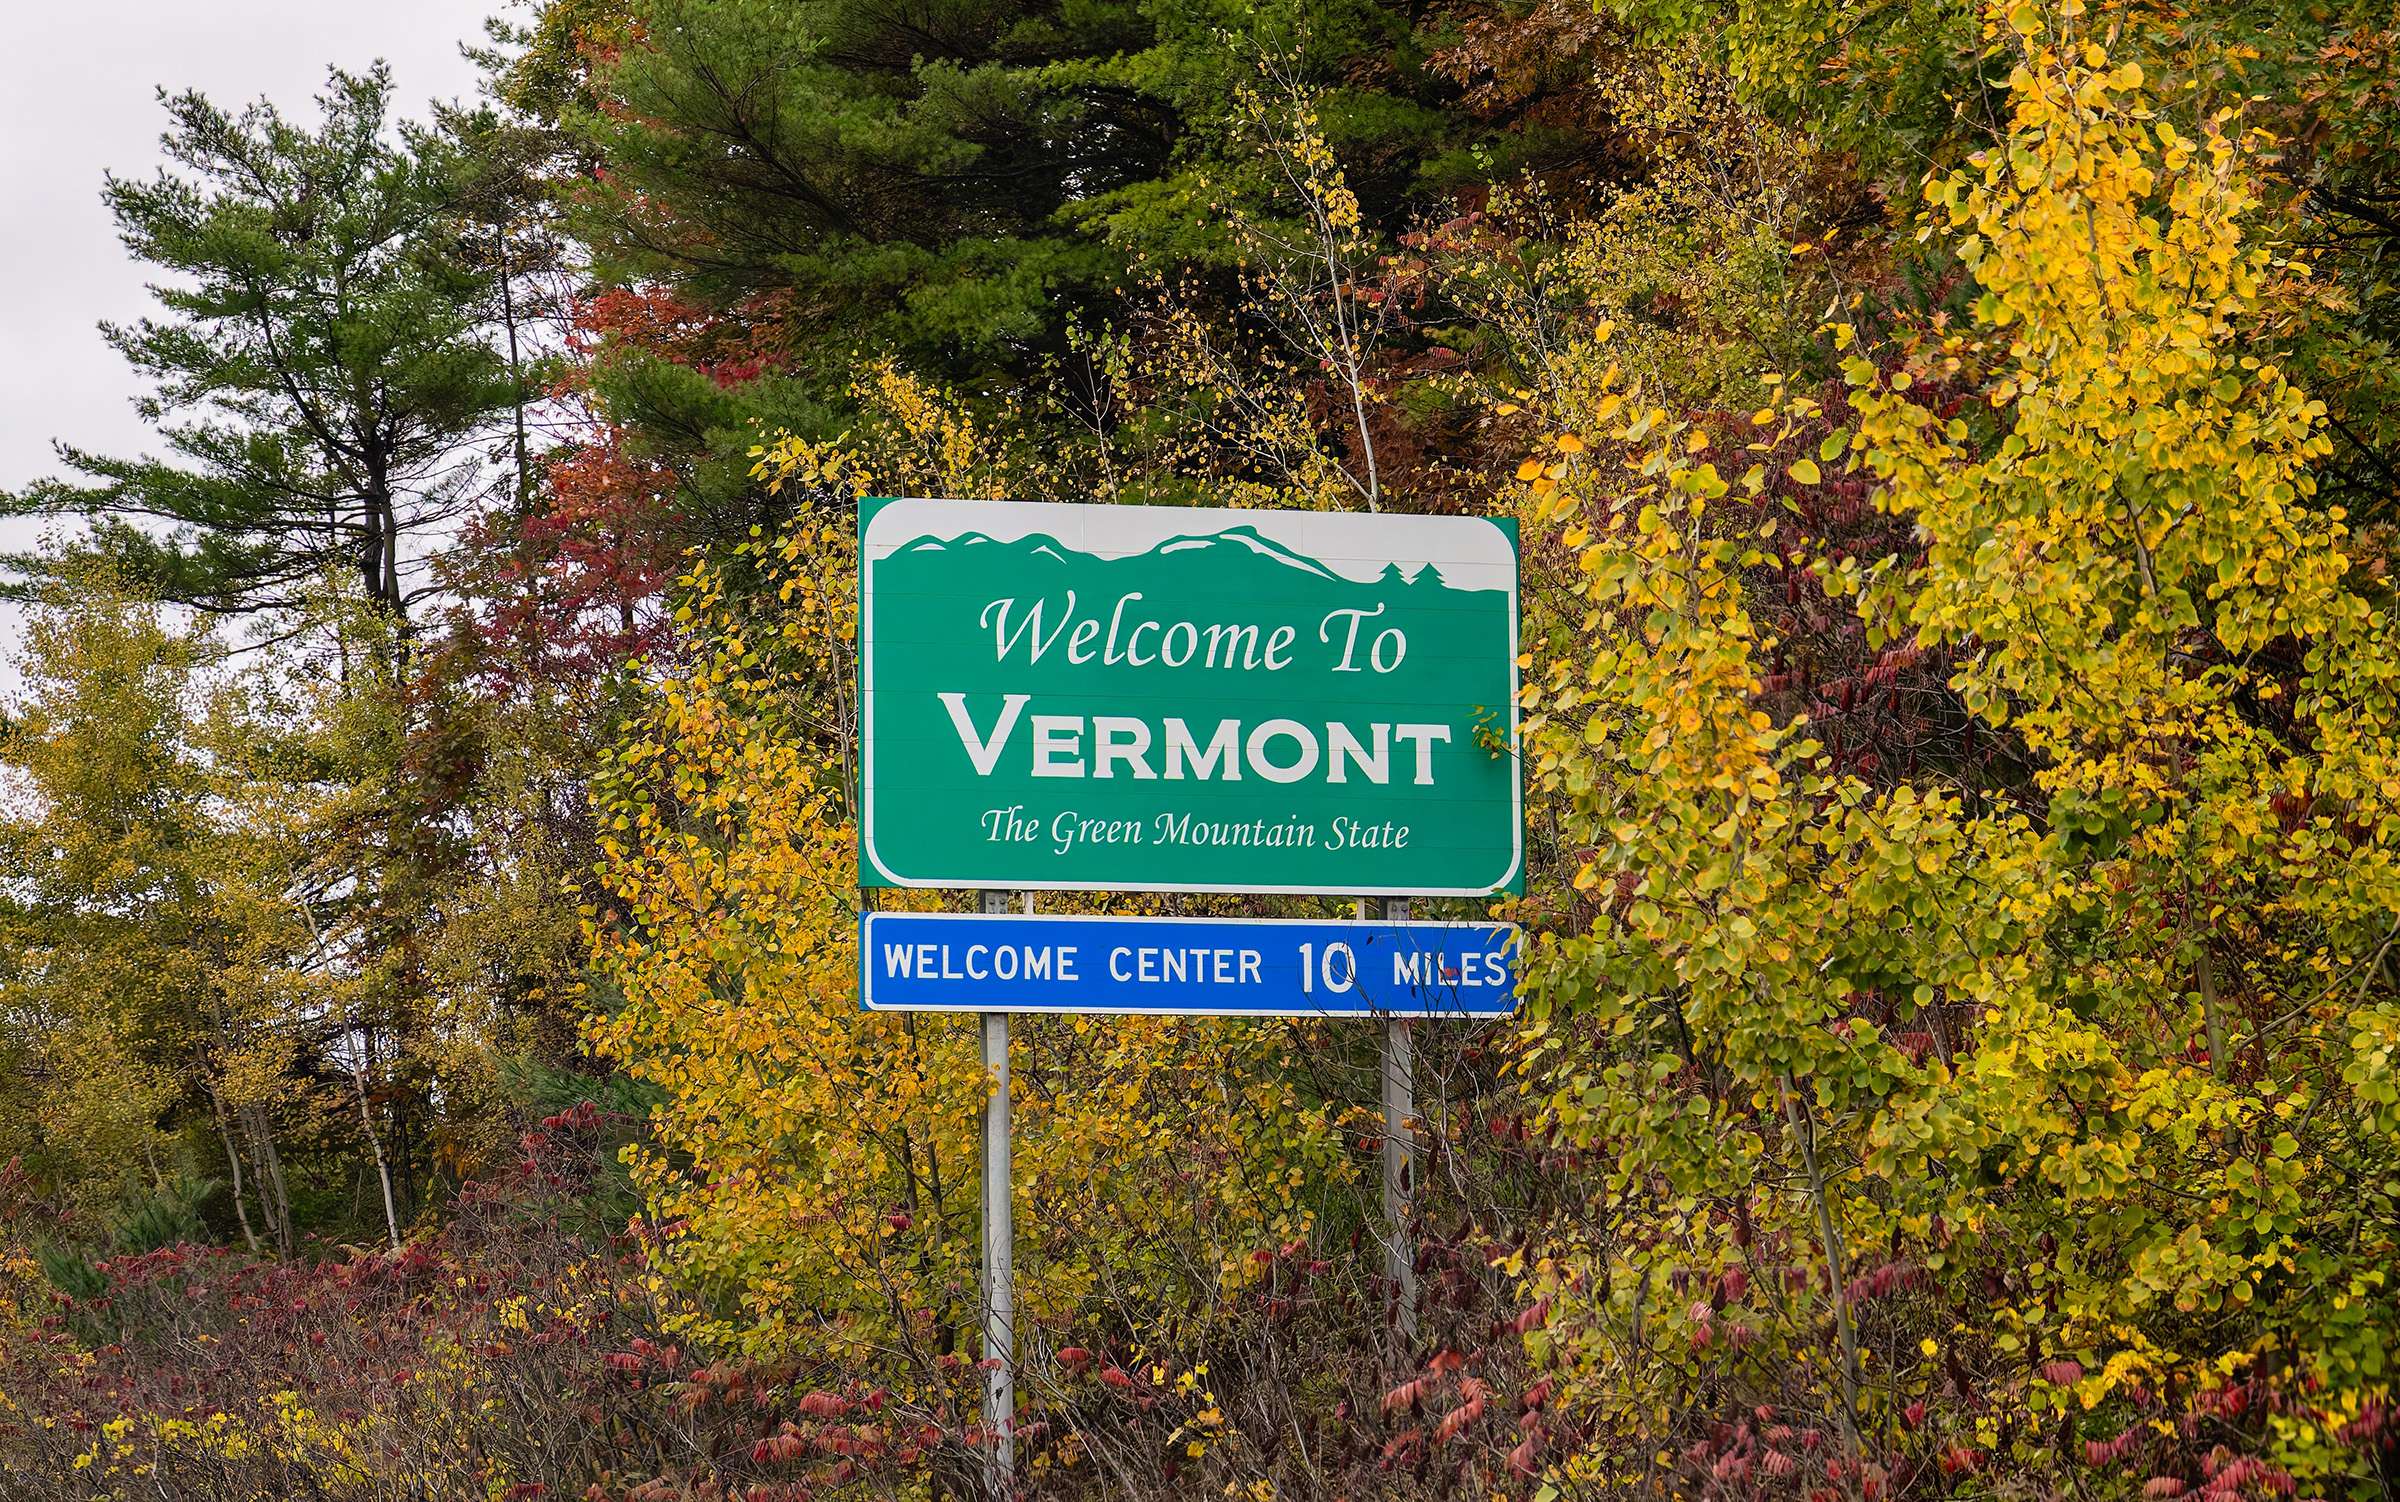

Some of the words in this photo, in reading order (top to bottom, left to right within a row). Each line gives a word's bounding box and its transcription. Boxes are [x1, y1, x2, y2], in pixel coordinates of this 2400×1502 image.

[980, 590, 1295, 671] Welcome
[1320, 602, 1407, 673] To
[938, 693, 1451, 785] VERMONT
[981, 805, 1040, 842] The
[1051, 812, 1142, 855] Green
[1152, 814, 1315, 847] Mountain
[1325, 817, 1410, 850] State
[884, 944, 1079, 981] WELCOME
[1109, 947, 1262, 984] CENTER
[1299, 942, 1356, 993] 10
[1394, 951, 1507, 987] MILES
